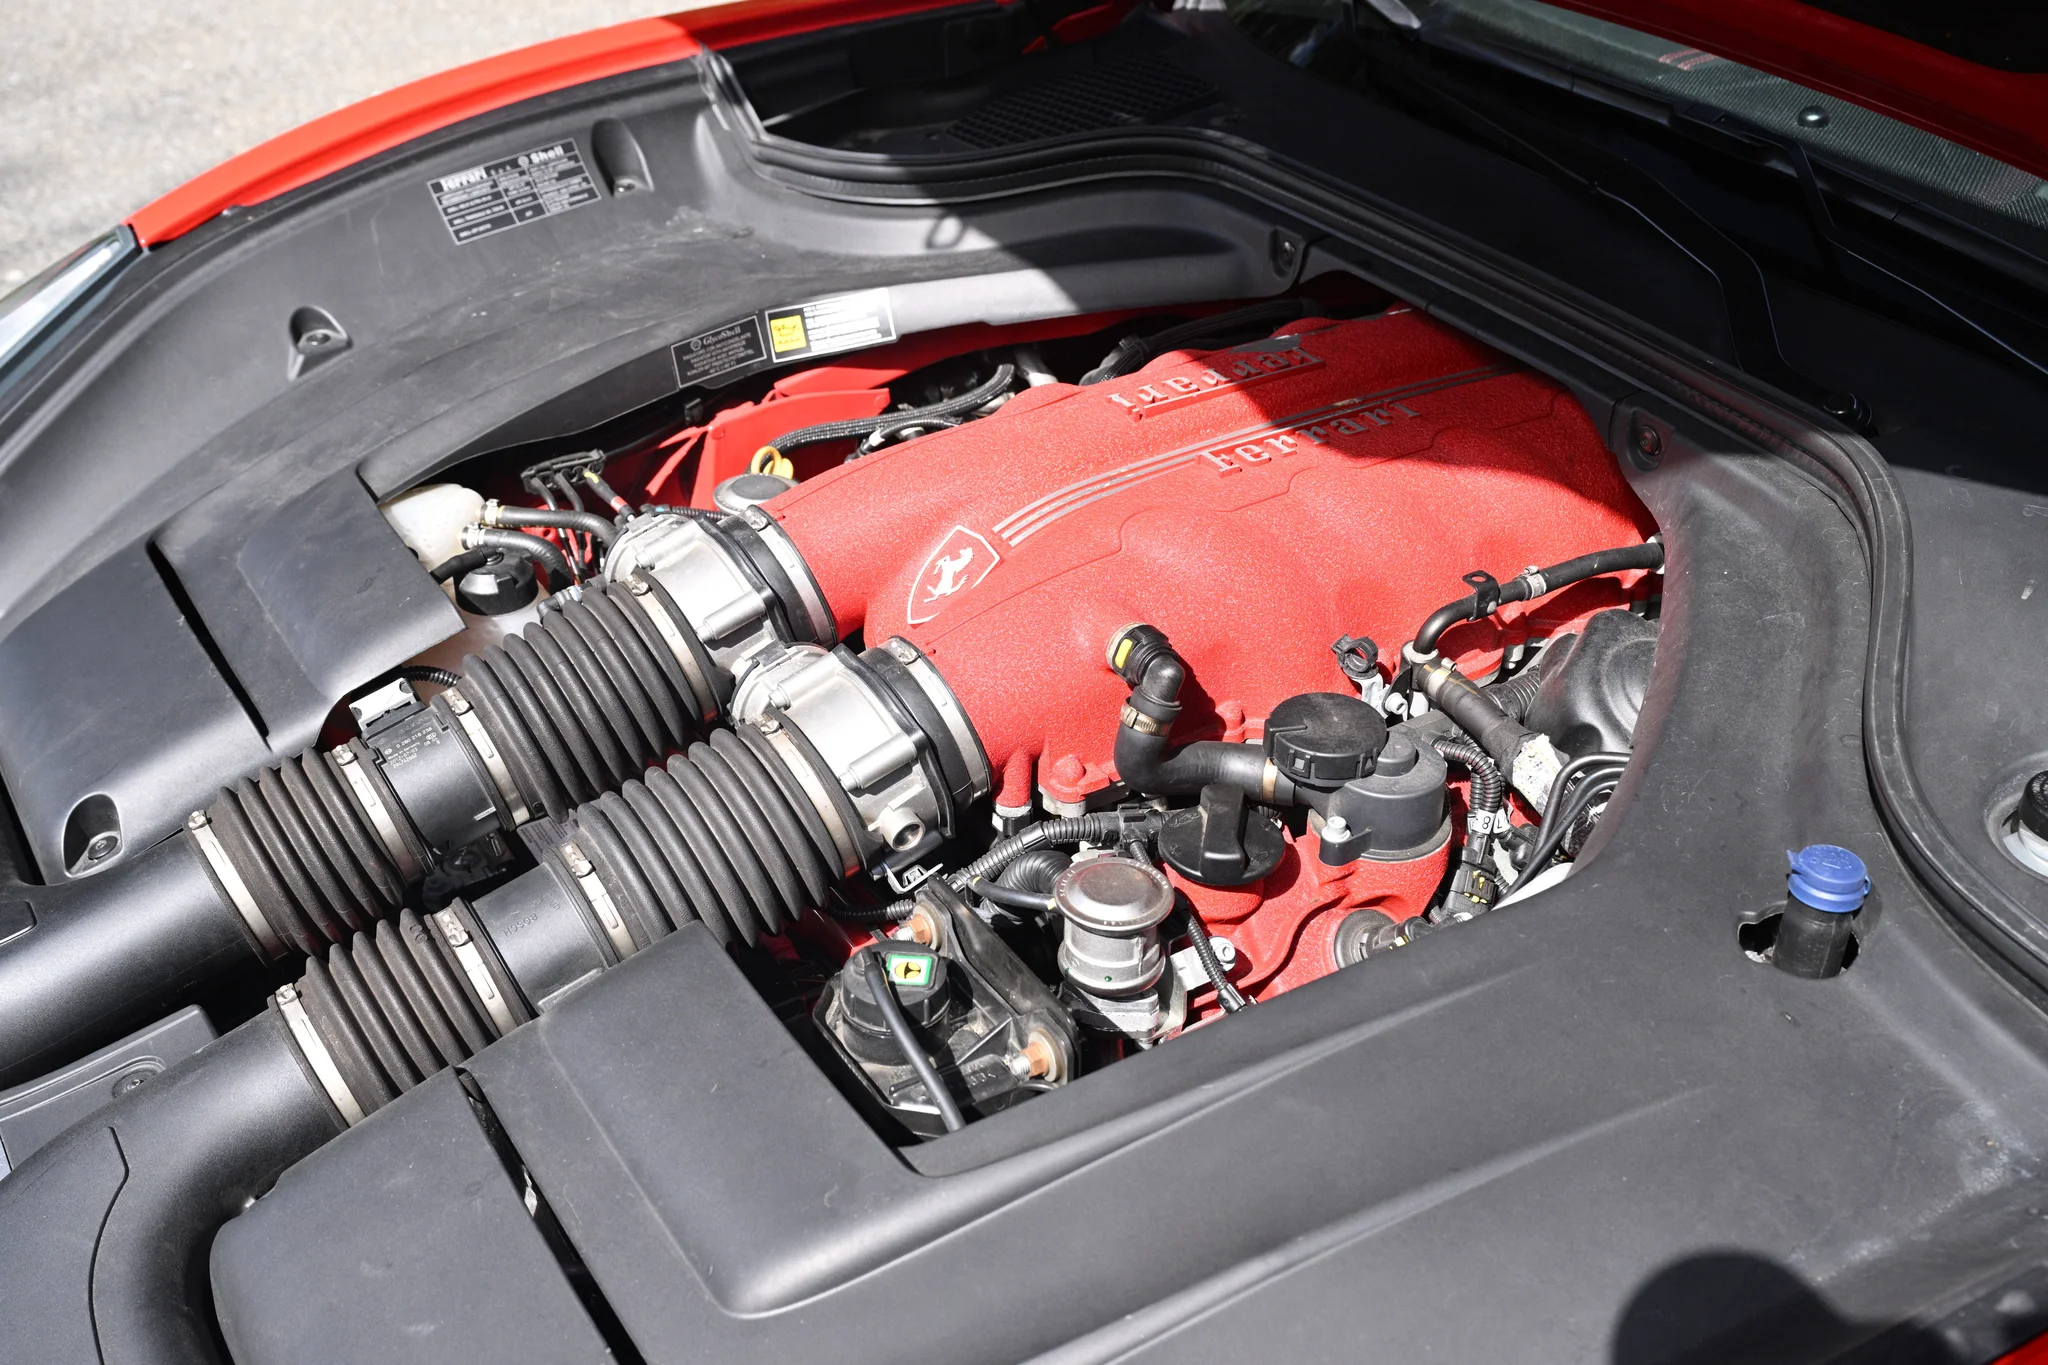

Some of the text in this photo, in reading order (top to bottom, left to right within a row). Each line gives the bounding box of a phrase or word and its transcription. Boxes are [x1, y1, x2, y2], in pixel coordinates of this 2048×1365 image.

[530, 144, 565, 165] Shell
[440, 166, 488, 192] Ferrari
[703, 326, 741, 345] GlycoShell
[1107, 347, 1325, 416] Ferrari
[1198, 400, 1421, 471] Ferrari
[1482, 816, 1491, 829] 8
[503, 912, 538, 937] BOSCH
